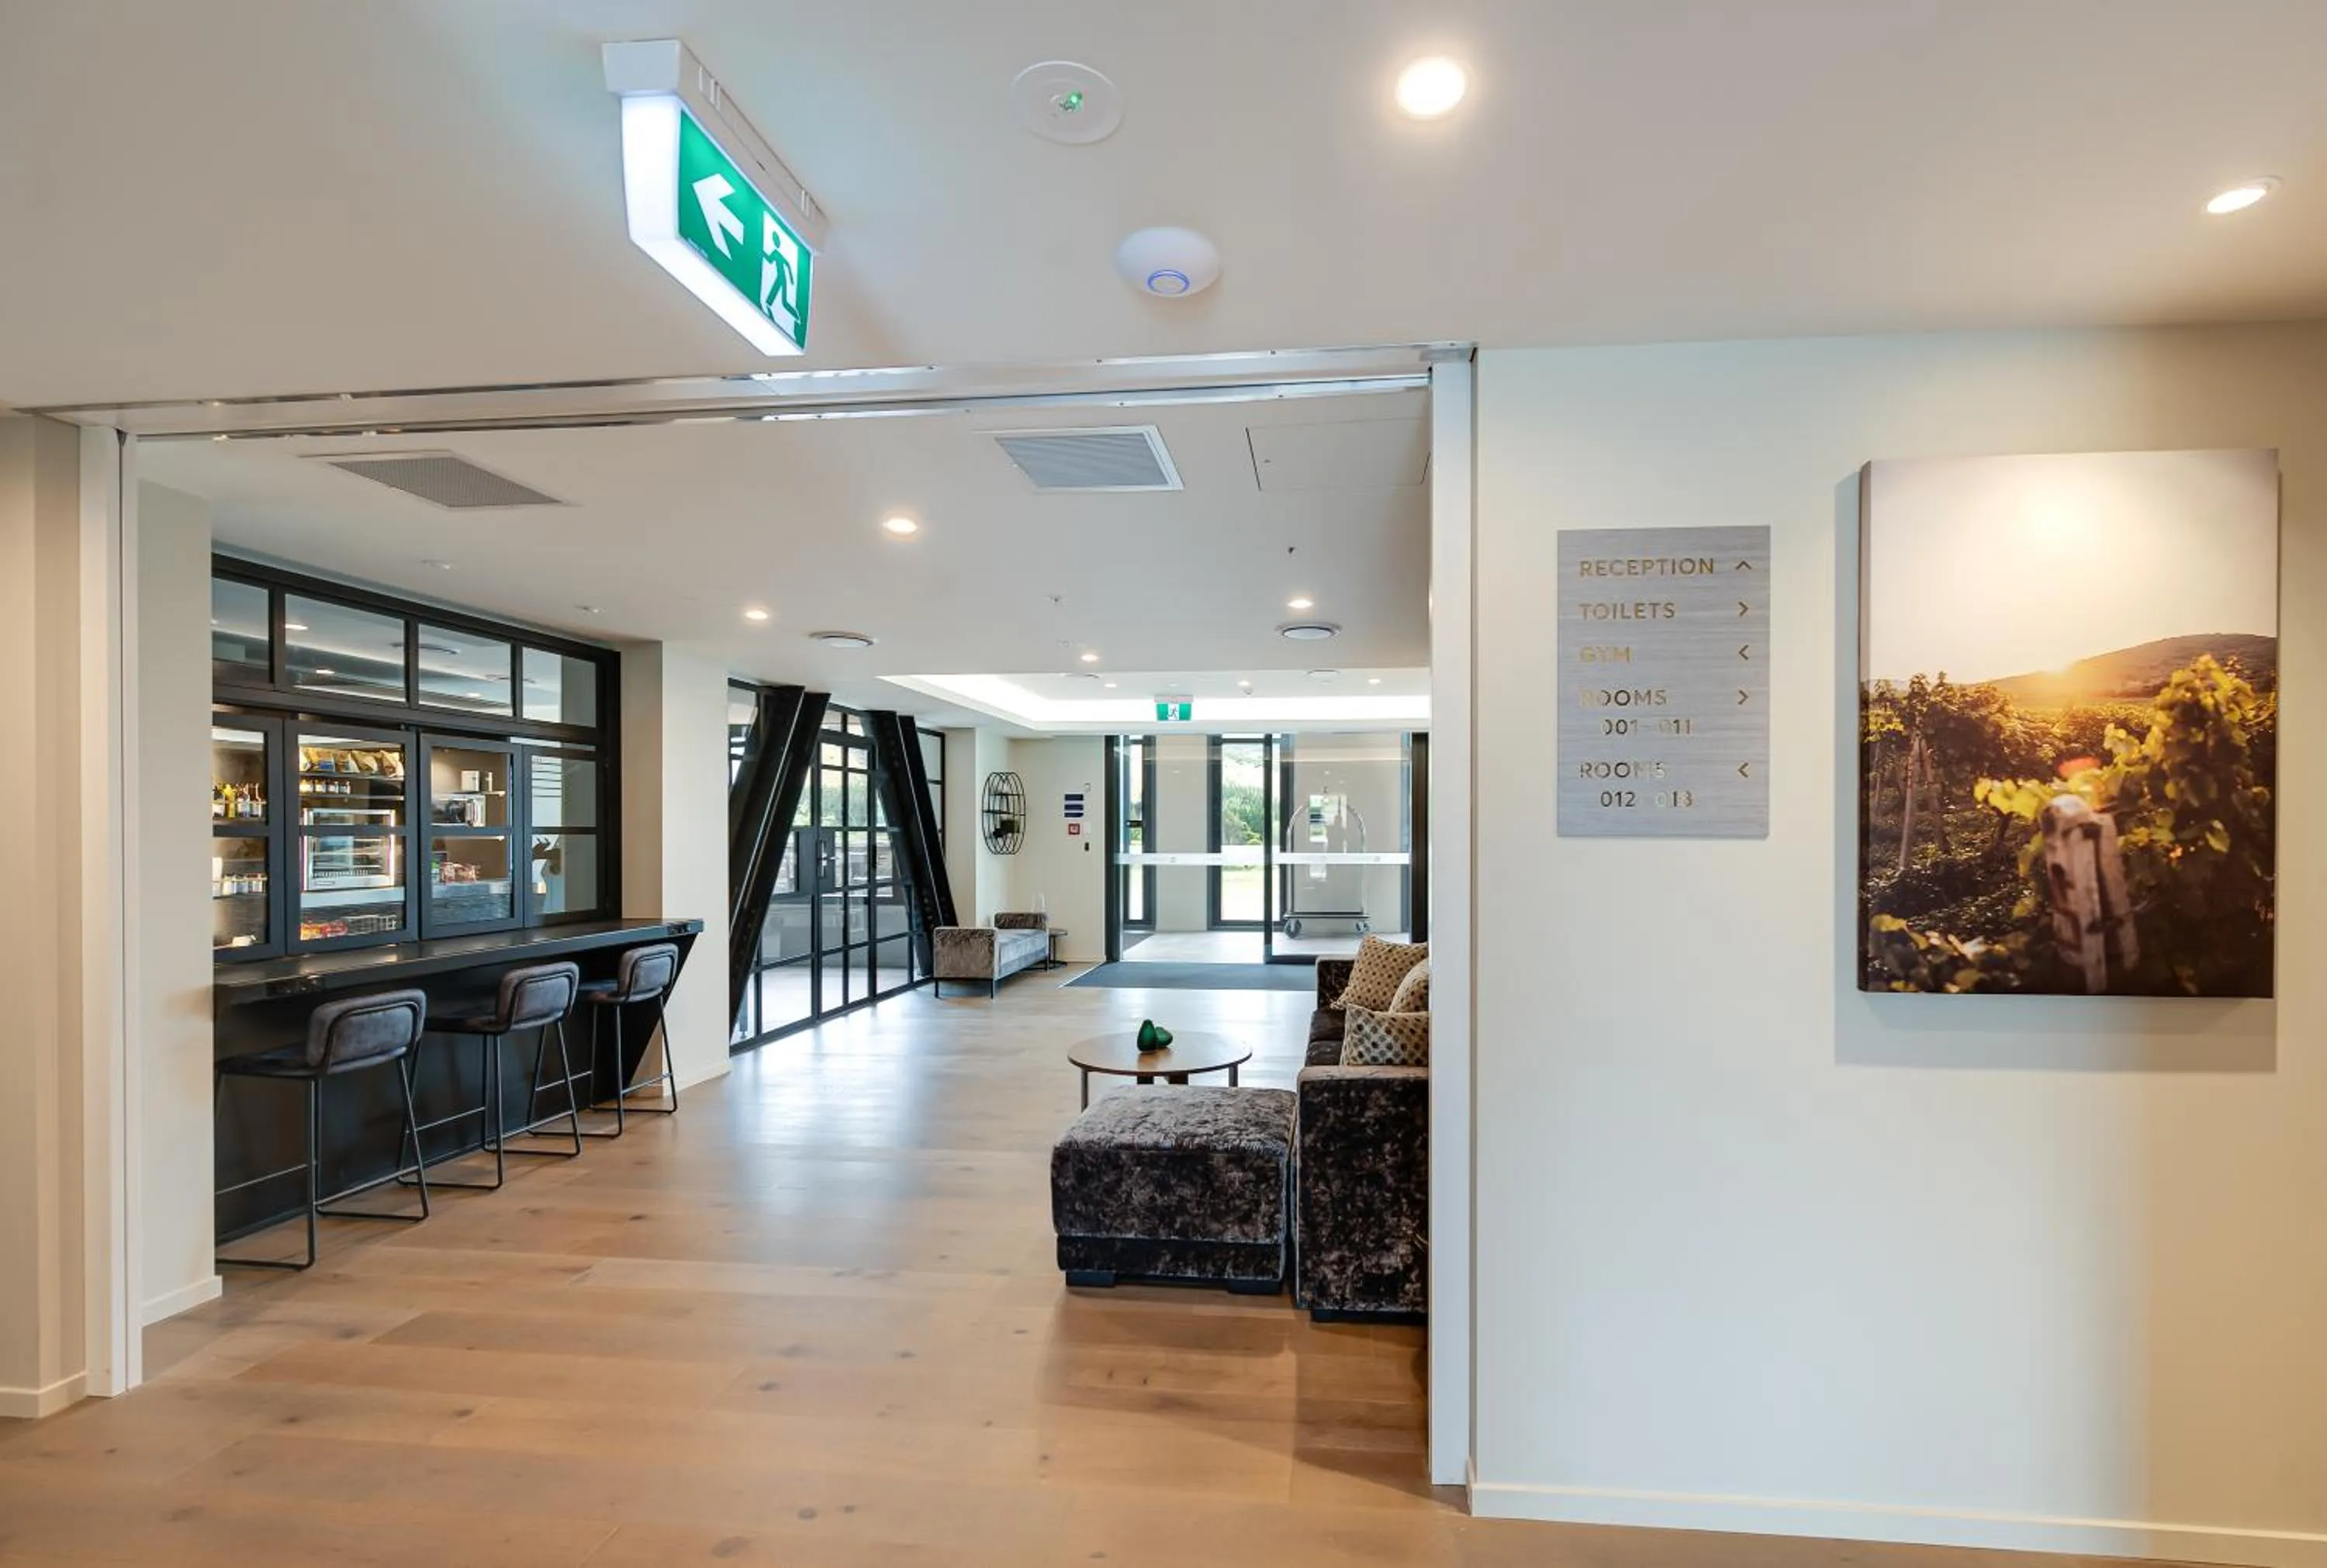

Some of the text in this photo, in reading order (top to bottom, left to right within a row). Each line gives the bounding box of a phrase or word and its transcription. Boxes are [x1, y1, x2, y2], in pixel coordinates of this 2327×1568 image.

[1579, 558, 1714, 577] RECEPTION
[1579, 603, 1675, 620] TOILETS
[1579, 647, 1631, 664] GYM
[1580, 689, 1667, 706] ROOMS
[1602, 719, 1639, 735] 001
[1579, 762, 1667, 779] ROOMS
[1600, 791, 1636, 807] 012
